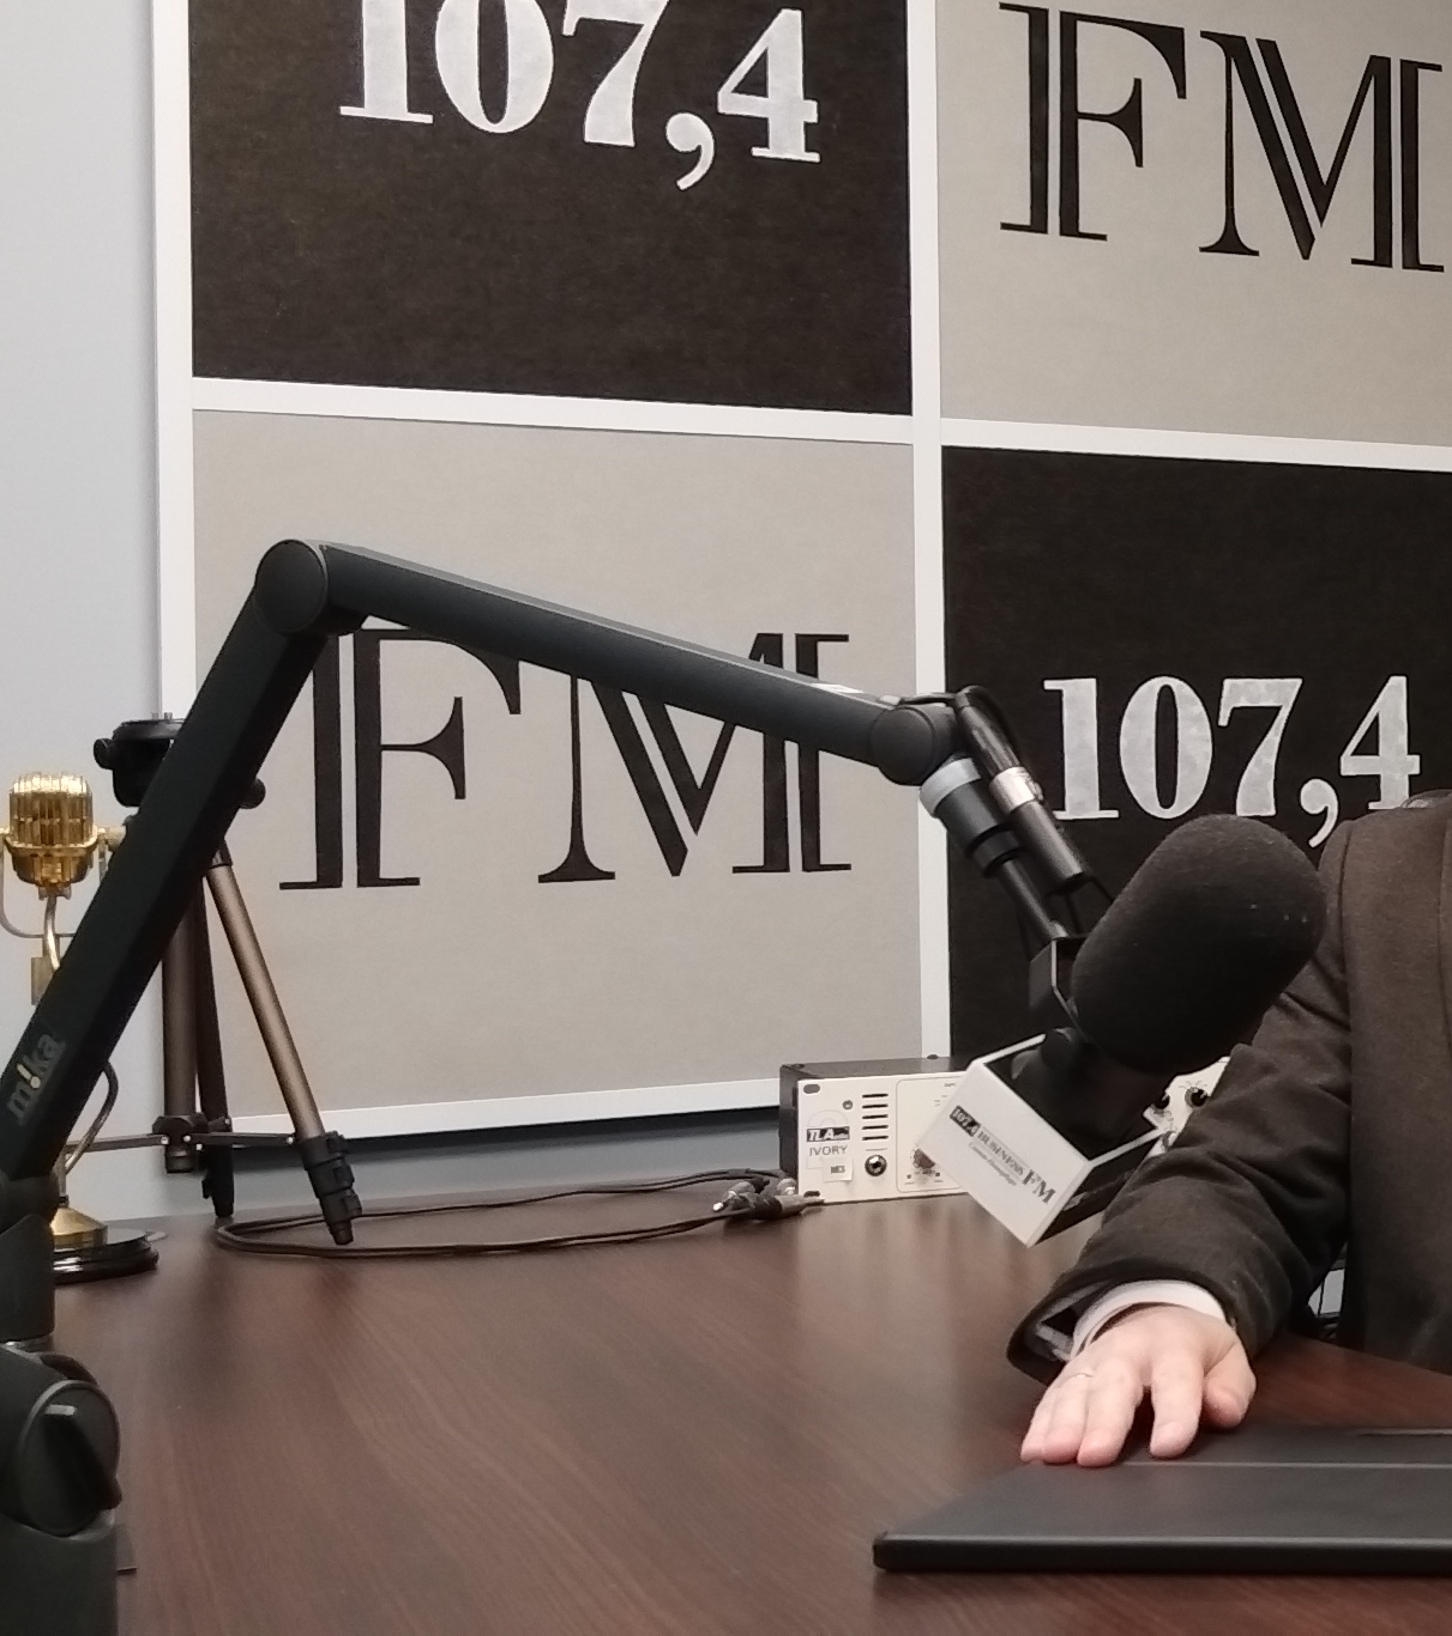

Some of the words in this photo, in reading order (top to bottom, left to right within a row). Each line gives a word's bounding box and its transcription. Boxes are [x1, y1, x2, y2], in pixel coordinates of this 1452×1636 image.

[340, 0, 821, 190] 107,4
[999, 2, 1444, 272] FM
[279, 629, 851, 889] FM
[1043, 675, 1421, 847] 107,4
[809, 1145, 848, 1156] IVORY
[1022, 1169, 1056, 1203] FM
